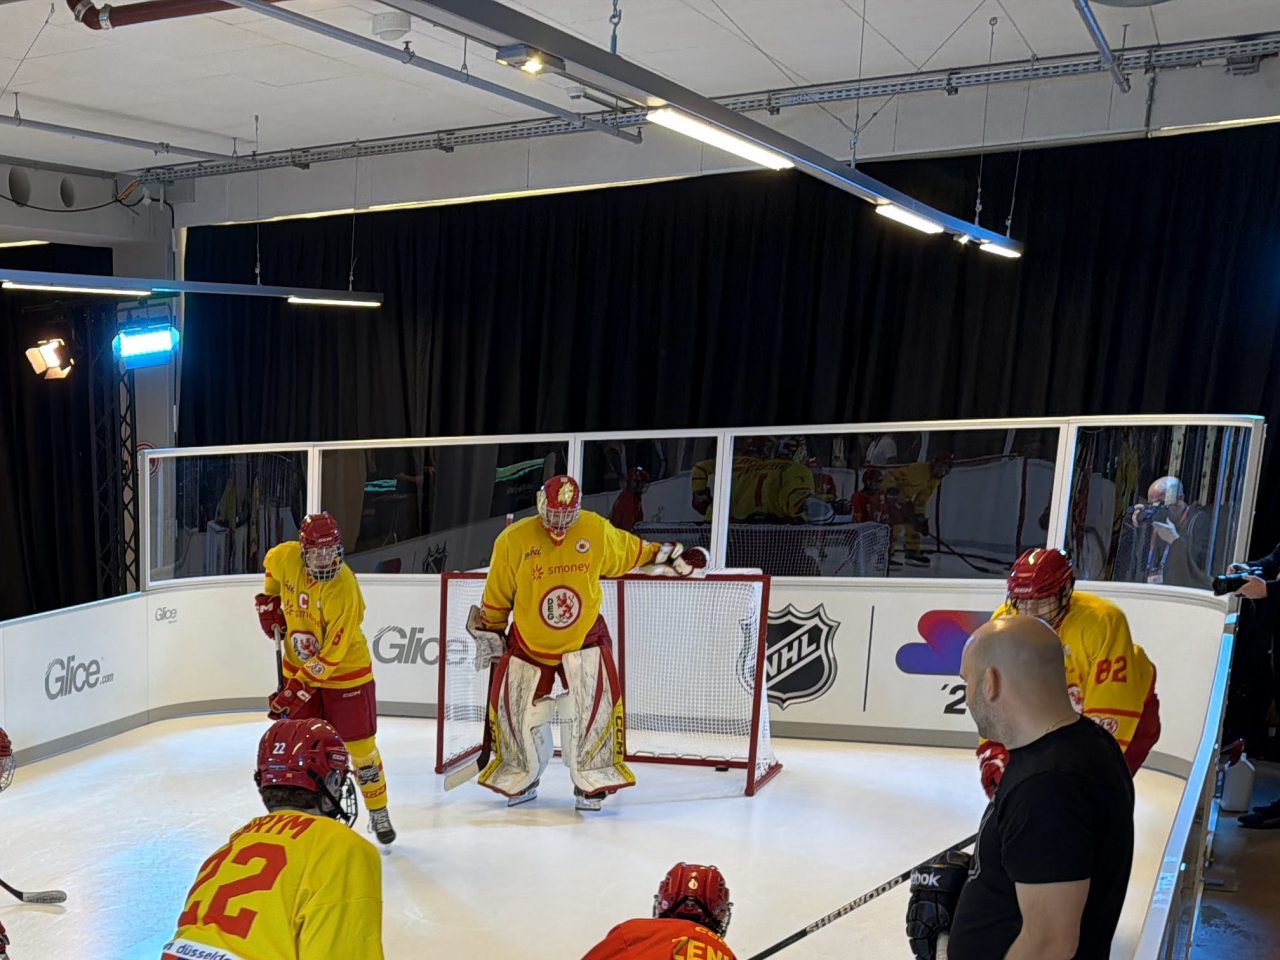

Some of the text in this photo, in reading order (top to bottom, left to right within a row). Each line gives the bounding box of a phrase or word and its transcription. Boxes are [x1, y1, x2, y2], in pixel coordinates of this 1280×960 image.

[548, 562, 590, 575] smoney
[155, 607, 177, 621] Glice
[44, 655, 101, 700] Glice
[1095, 656, 1128, 685] 82
[273, 743, 286, 754] 22
[615, 715, 623, 756] CCM
[806, 876, 903, 934] SHERWOOD
